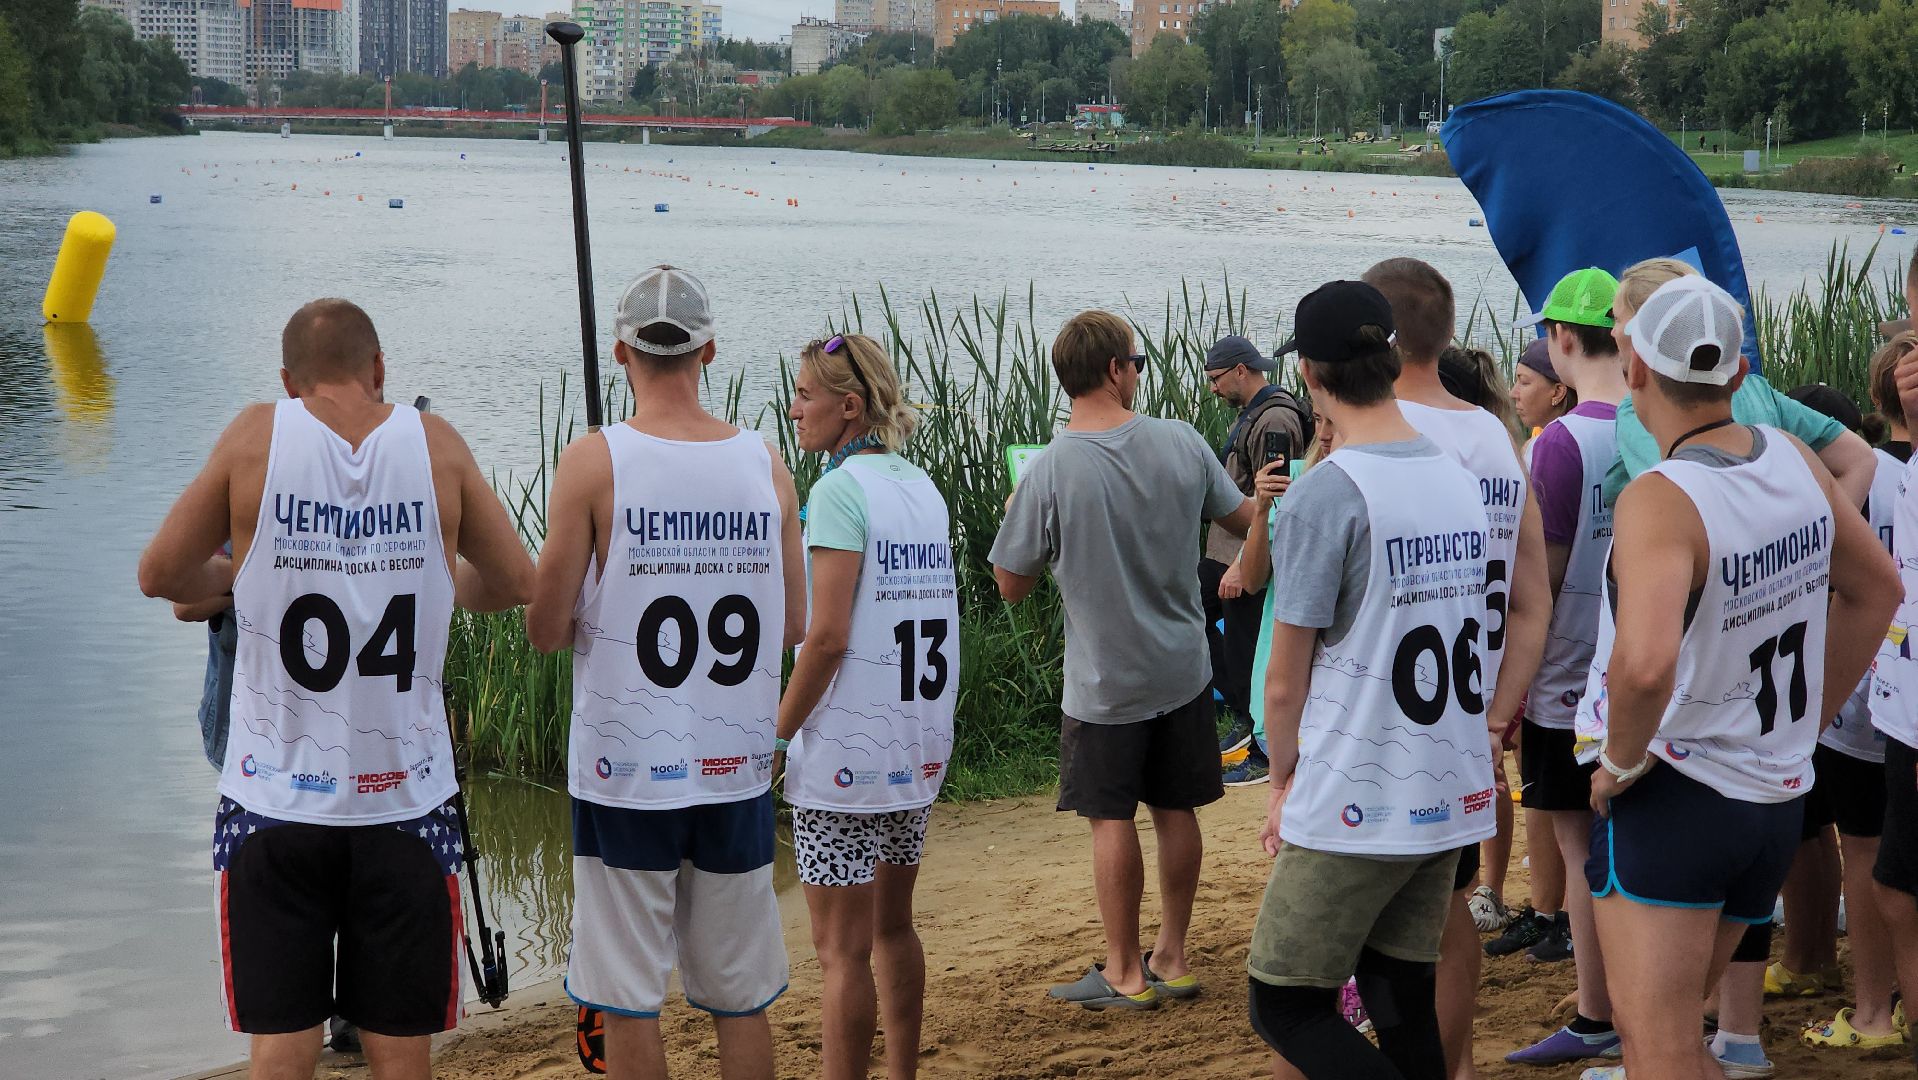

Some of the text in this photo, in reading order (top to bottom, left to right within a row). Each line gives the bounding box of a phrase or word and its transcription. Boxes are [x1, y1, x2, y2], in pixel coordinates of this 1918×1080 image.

[275, 494, 424, 540] ЧЕМПИОНАТ
[626, 507, 771, 546] ЧЕМПИОНАТ
[273, 556, 343, 572] ДИСЦИПЛИНА
[380, 560, 386, 571] С
[628, 545, 771, 560] МОСКОВСКОЙ ОБЛАСТИ ПО СЕРФИНГУ
[628, 562, 770, 577] ДИСЦИПЛИНА ДОСКА С ВЕСЛОМ
[1722, 515, 1827, 597] ЧЕМПИОНАТ
[1722, 601, 1775, 633] ДИСЦИПЛИНА
[279, 593, 416, 693] 04
[636, 594, 760, 688] 09
[893, 619, 948, 701] 13
[1392, 617, 1485, 726] 06
[1748, 620, 1808, 737] 11
[701, 766, 738, 776] СПОРТ
[702, 756, 748, 767] МОСОБЛ
